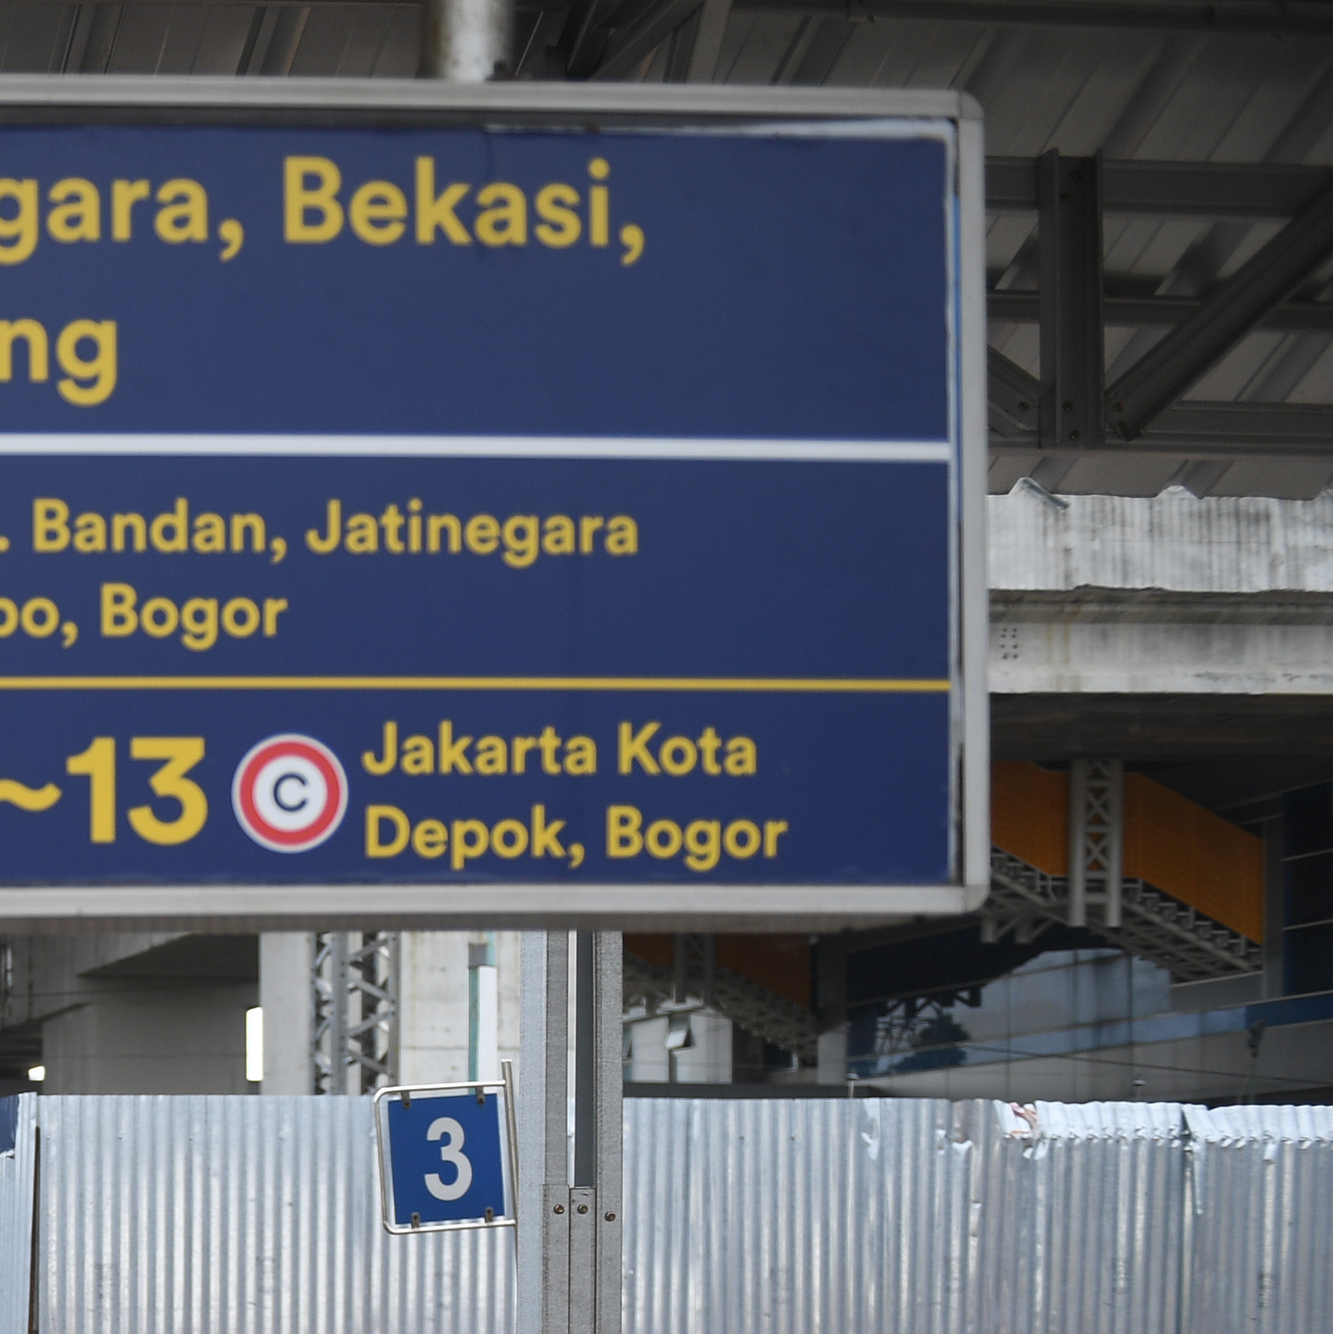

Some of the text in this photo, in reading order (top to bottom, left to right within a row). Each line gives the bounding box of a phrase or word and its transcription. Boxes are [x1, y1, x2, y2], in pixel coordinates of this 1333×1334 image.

[283, 154, 646, 266] Bekasi,
[32, 496, 289, 564] Bandan,
[305, 497, 639, 569] Jatinegara
[100, 581, 290, 652] Bogor
[361, 719, 758, 777] Jakarta Kota
[272, 772, 309, 813] C
[364, 802, 790, 873] Depok, Bogor
[424, 1116, 473, 1202] 3
